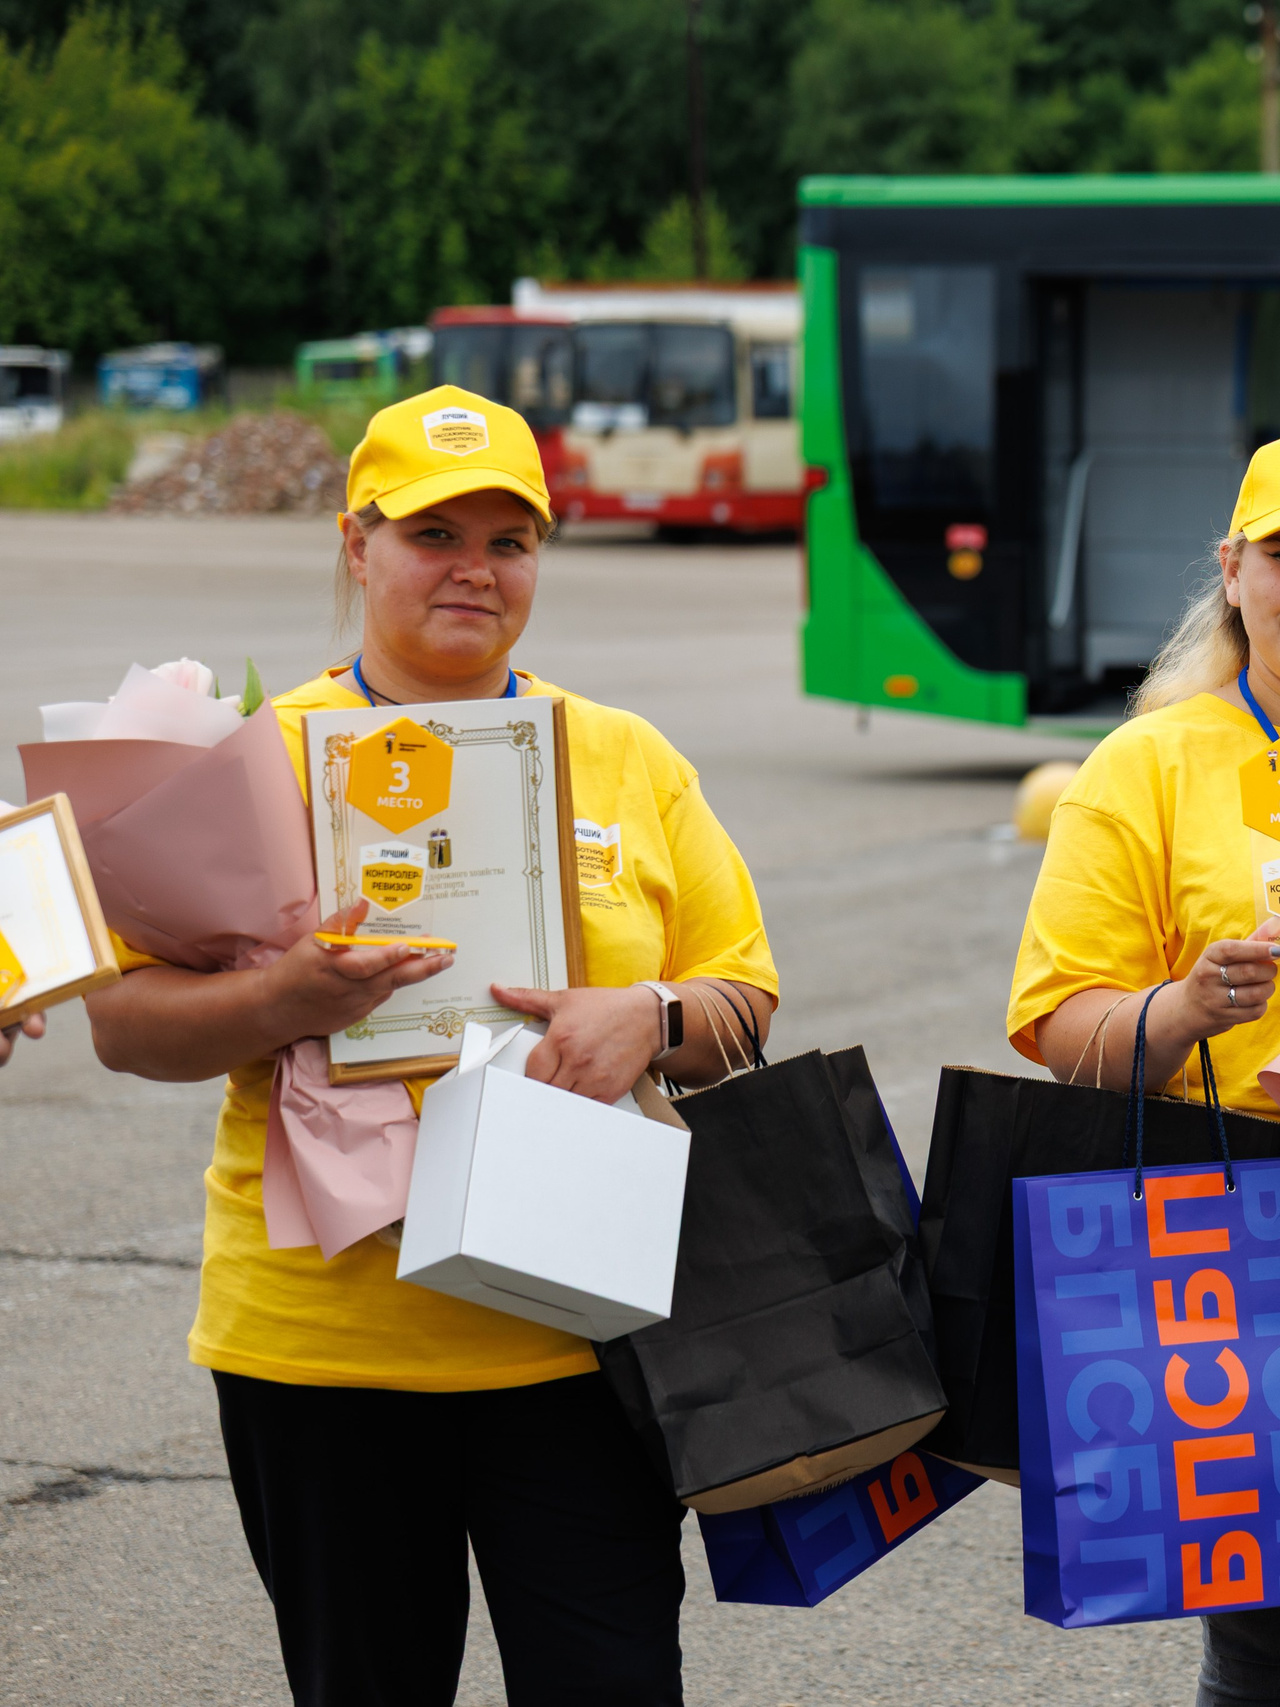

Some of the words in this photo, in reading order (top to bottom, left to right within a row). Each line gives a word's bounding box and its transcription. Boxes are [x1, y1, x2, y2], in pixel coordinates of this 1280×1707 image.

[388, 761, 411, 794] 3
[376, 796, 424, 809] МЕСТО
[380, 848, 409, 859] ЛУЧШИЙ
[366, 869, 422, 880] КОНТРОЛЕР-
[372, 881, 413, 892] РЕВИЗОР
[1144, 1172, 1264, 1611] БПСБП
